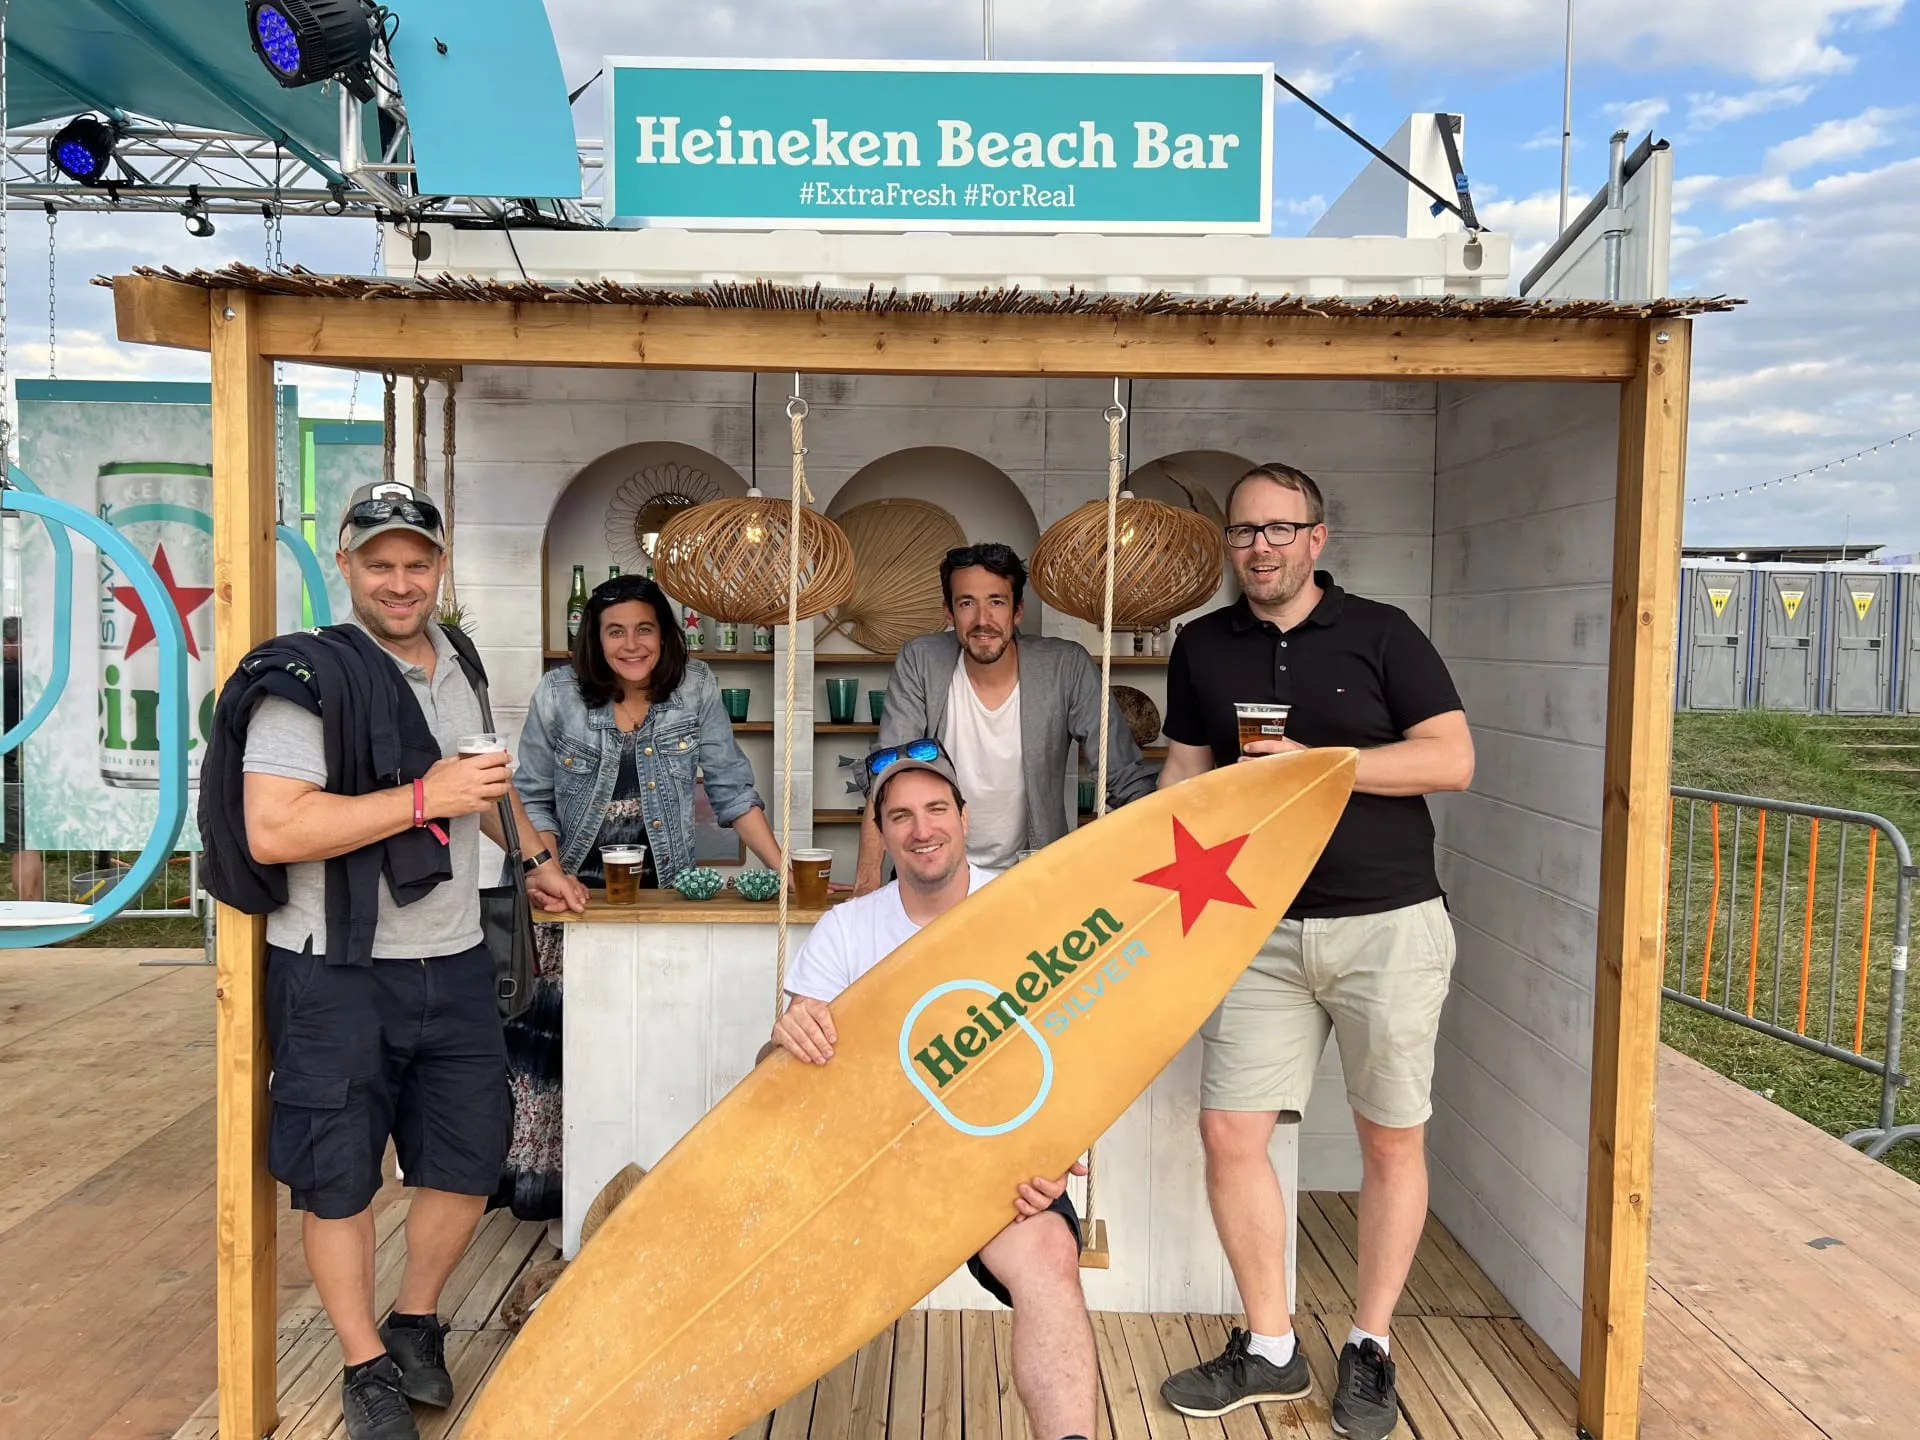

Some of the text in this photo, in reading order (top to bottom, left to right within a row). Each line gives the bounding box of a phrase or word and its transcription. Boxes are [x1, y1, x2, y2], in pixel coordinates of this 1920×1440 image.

[635, 115, 1240, 170] Heineken Beach Bar
[799, 181, 1076, 208] #ExtraFresh #ForReal
[99, 503, 116, 643] SILVR
[913, 906, 1125, 1088] Heineken
[1042, 938, 1151, 1037] SILVER
